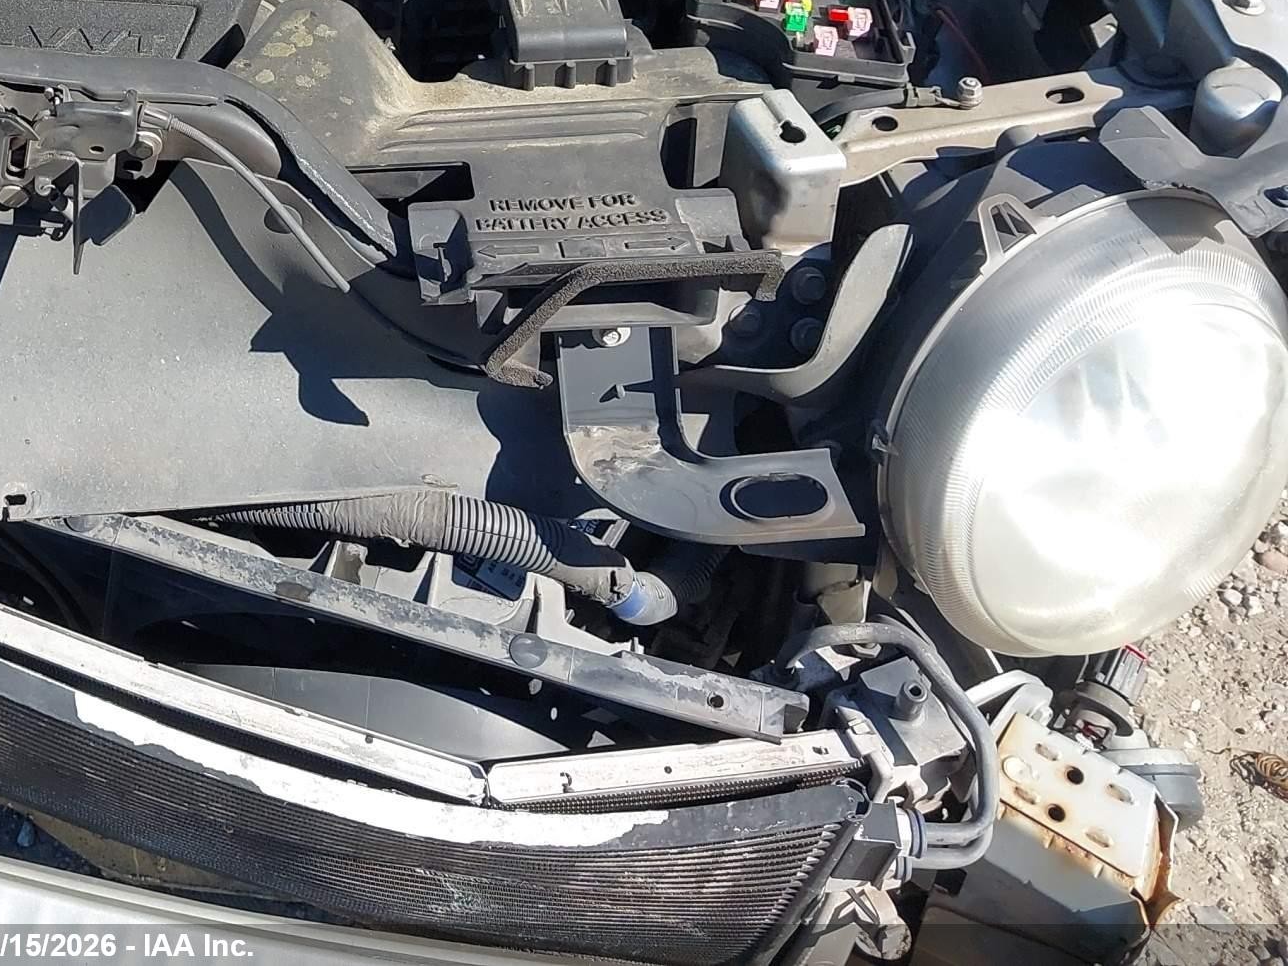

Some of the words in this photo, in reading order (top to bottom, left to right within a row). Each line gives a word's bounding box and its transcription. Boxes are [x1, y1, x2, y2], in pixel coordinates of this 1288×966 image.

[488, 197, 585, 212] REMOVE
[587, 192, 638, 209] FOR
[475, 216, 570, 232] BATTERY
[577, 208, 669, 229] ACCESS
